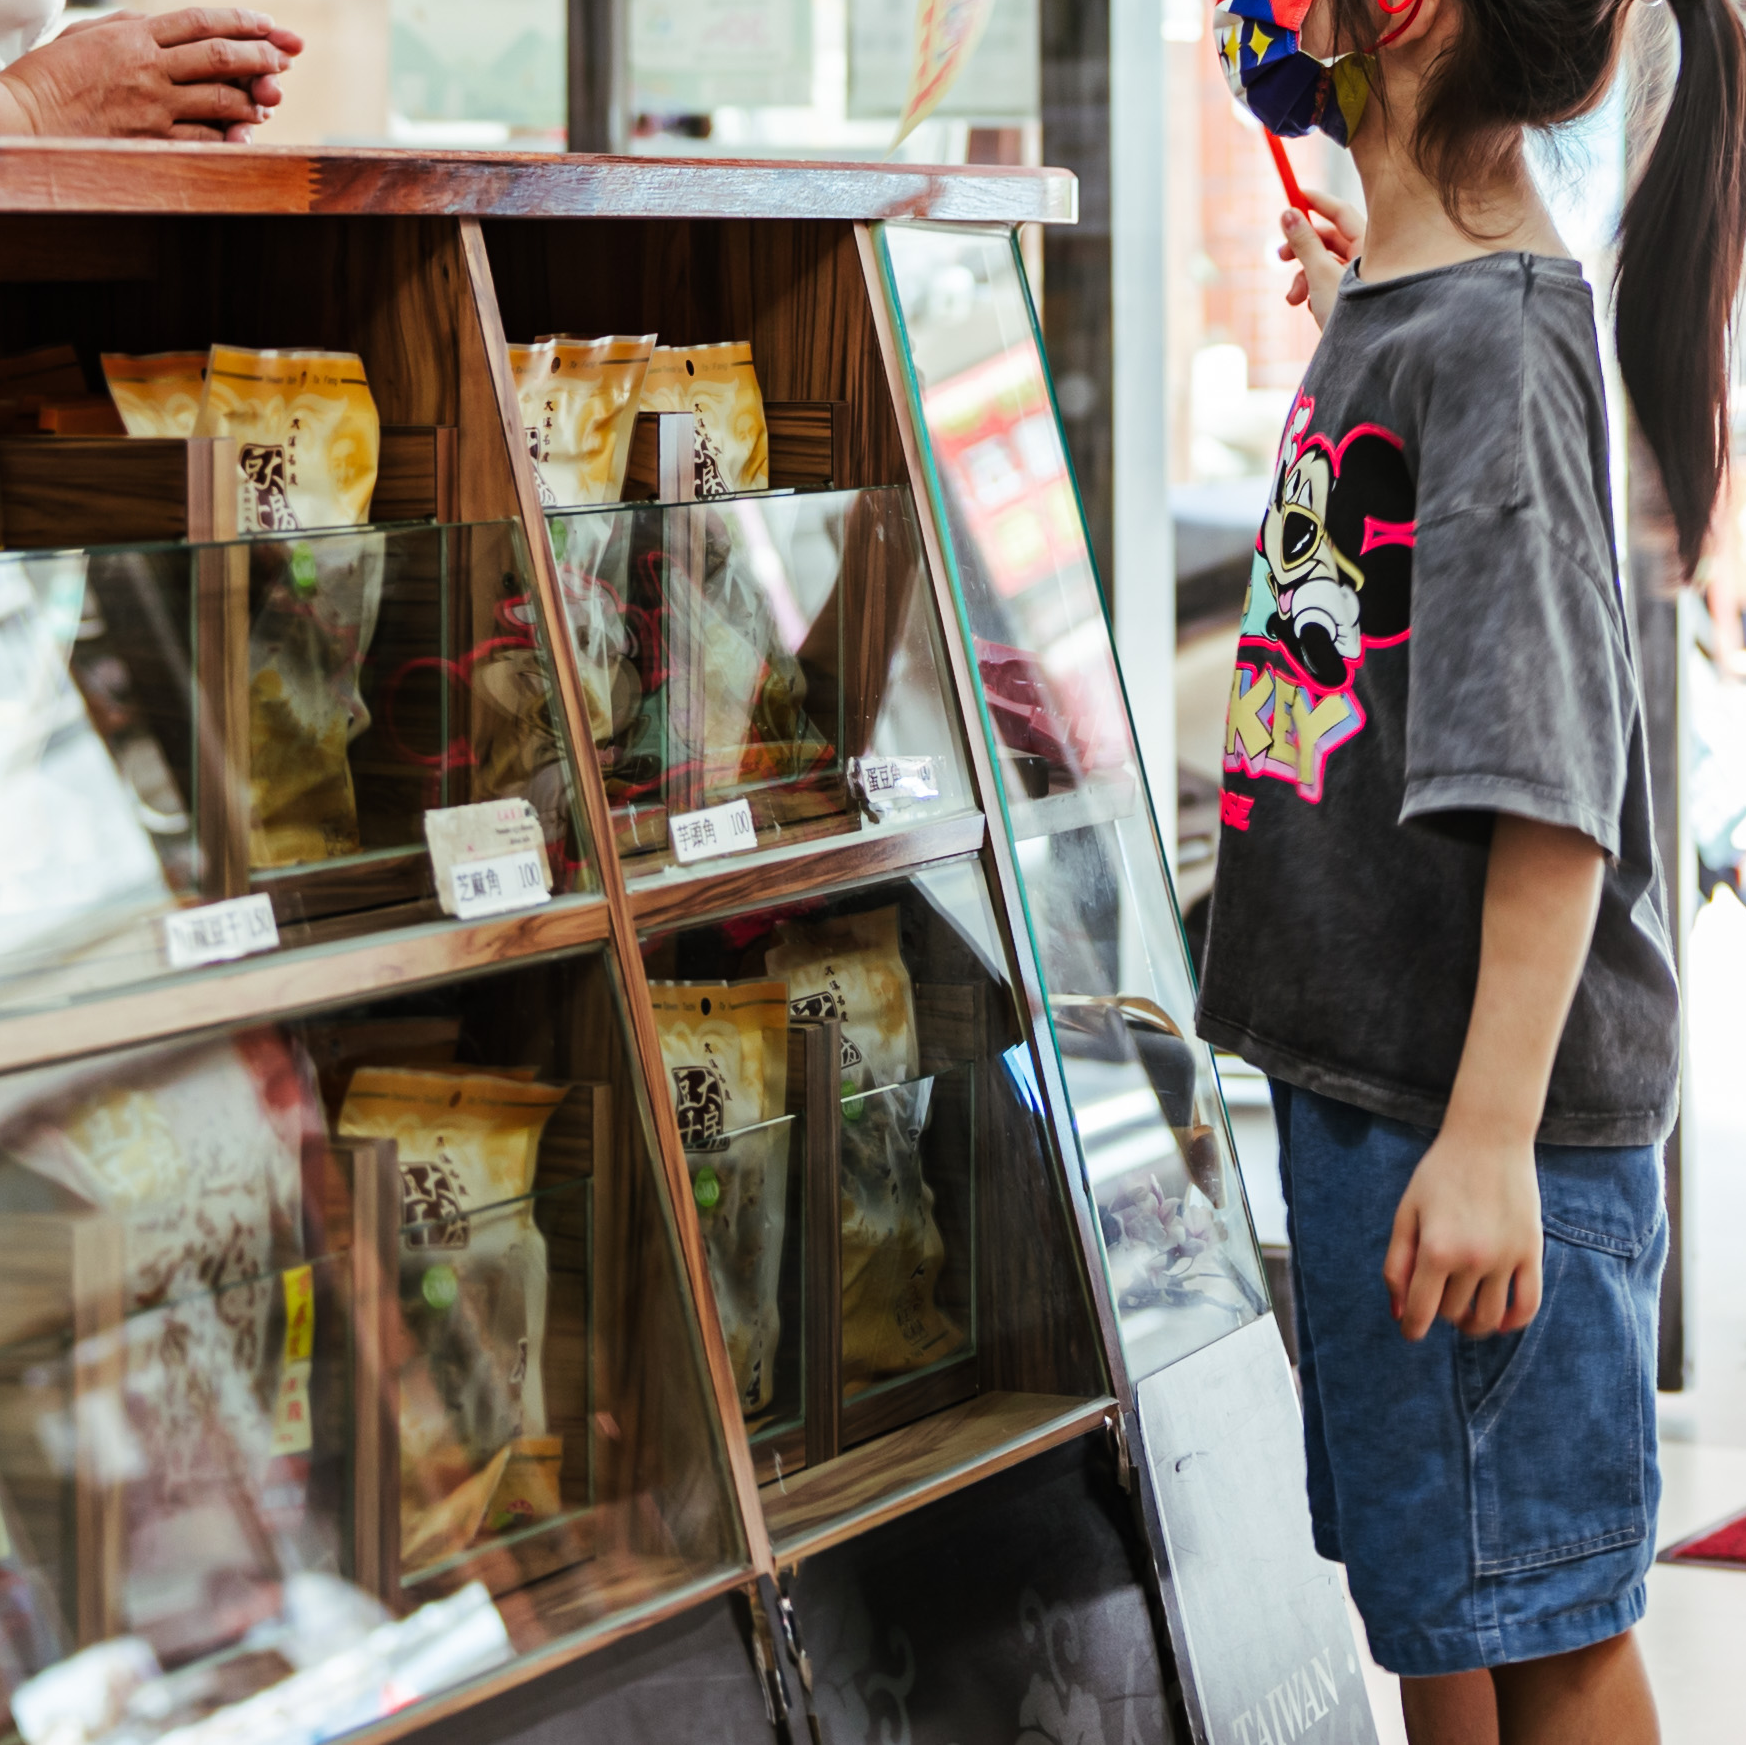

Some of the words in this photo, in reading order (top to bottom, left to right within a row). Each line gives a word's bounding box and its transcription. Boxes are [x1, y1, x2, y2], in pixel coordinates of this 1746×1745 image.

[677, 818, 717, 851] 芋頭角
[730, 811, 749, 835] 100
[456, 868, 502, 902] 芝麻角
[518, 862, 541, 888] 100
